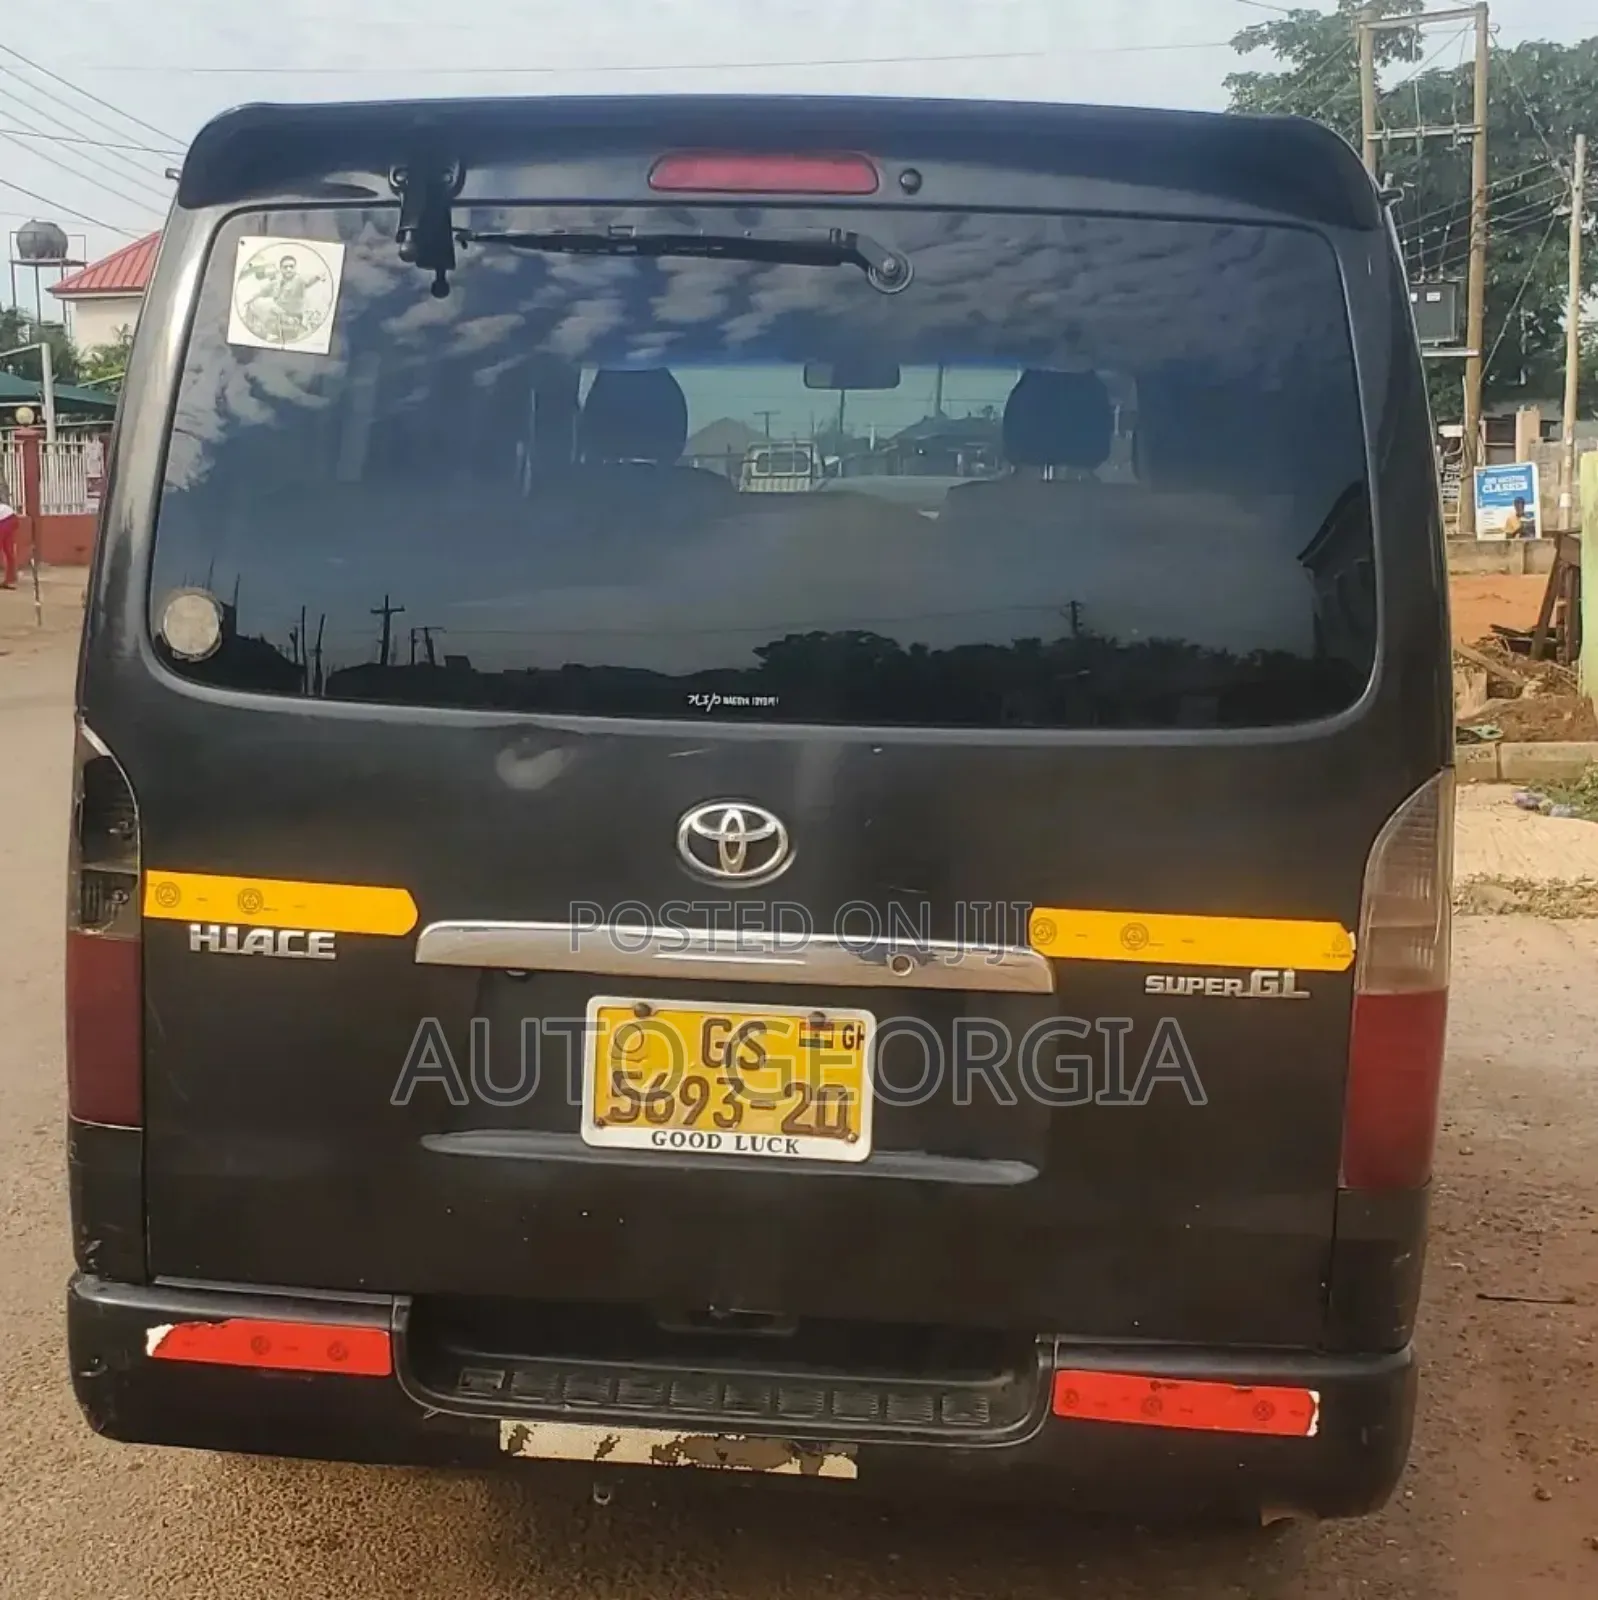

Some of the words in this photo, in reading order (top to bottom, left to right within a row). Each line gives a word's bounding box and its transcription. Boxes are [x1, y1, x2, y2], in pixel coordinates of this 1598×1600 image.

[189, 923, 337, 960] HIACE
[1145, 974, 1243, 998] SUPER
[1249, 969, 1311, 999] GL
[701, 1017, 768, 1071] GS
[609, 1070, 851, 1140] 5693-20
[651, 1130, 722, 1149] GOOD
[735, 1135, 800, 1154] LUCK
